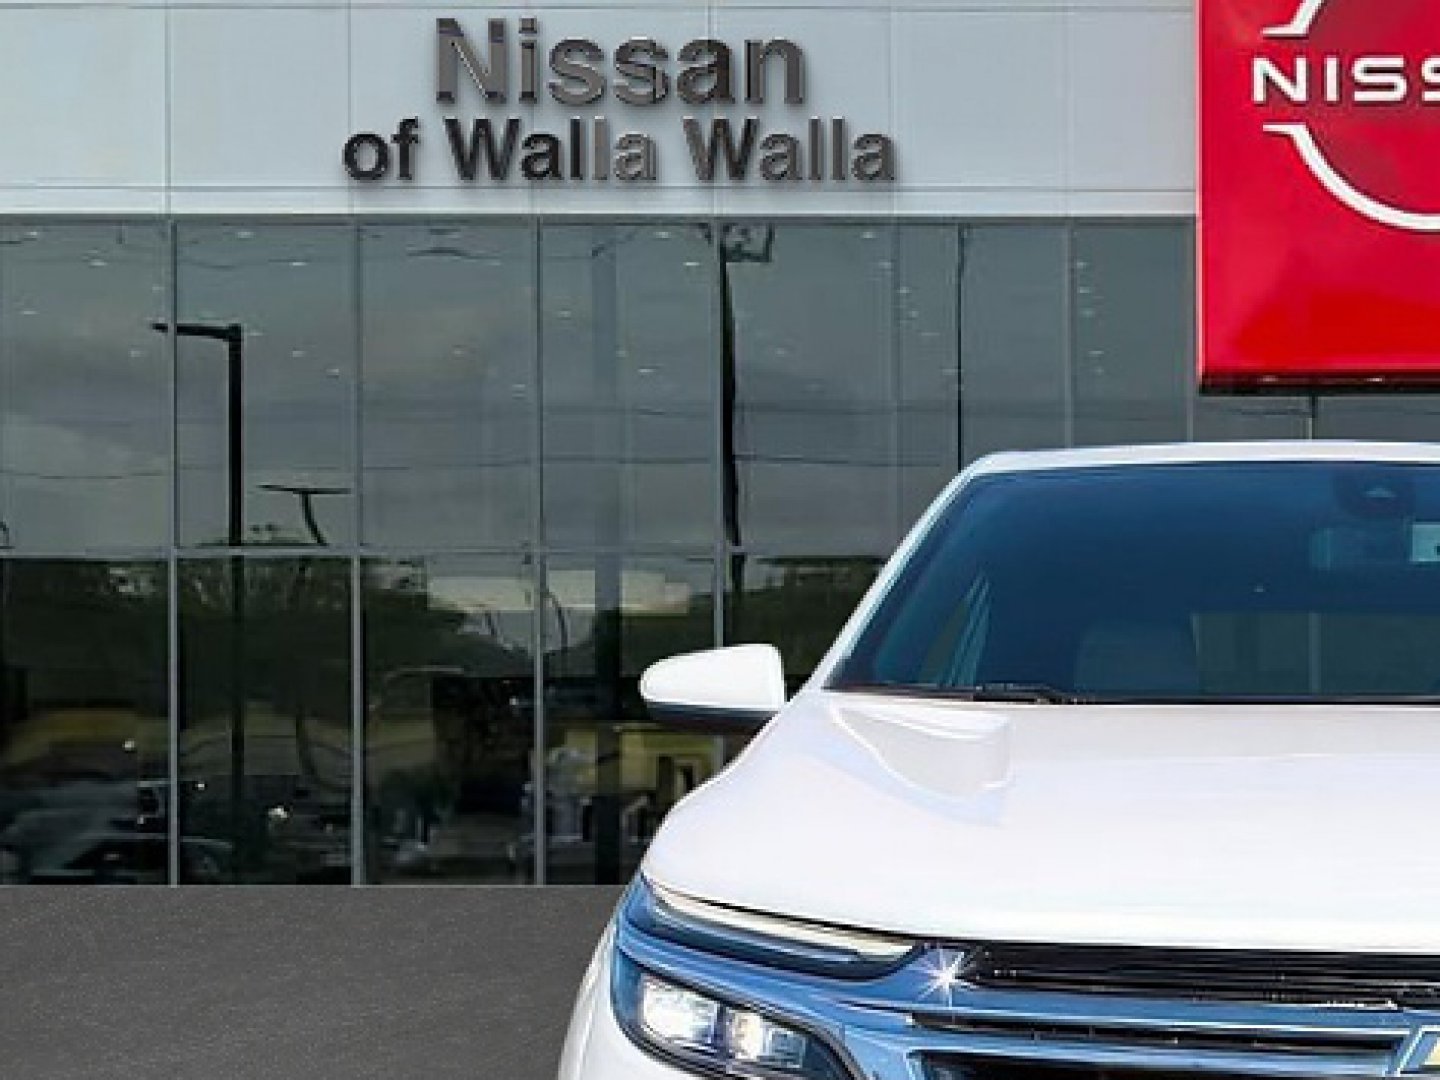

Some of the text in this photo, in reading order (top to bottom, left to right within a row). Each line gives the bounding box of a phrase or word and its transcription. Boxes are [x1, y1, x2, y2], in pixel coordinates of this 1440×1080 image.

[435, 17, 807, 105] Nissan
[343, 116, 895, 181] of Walla Walla
